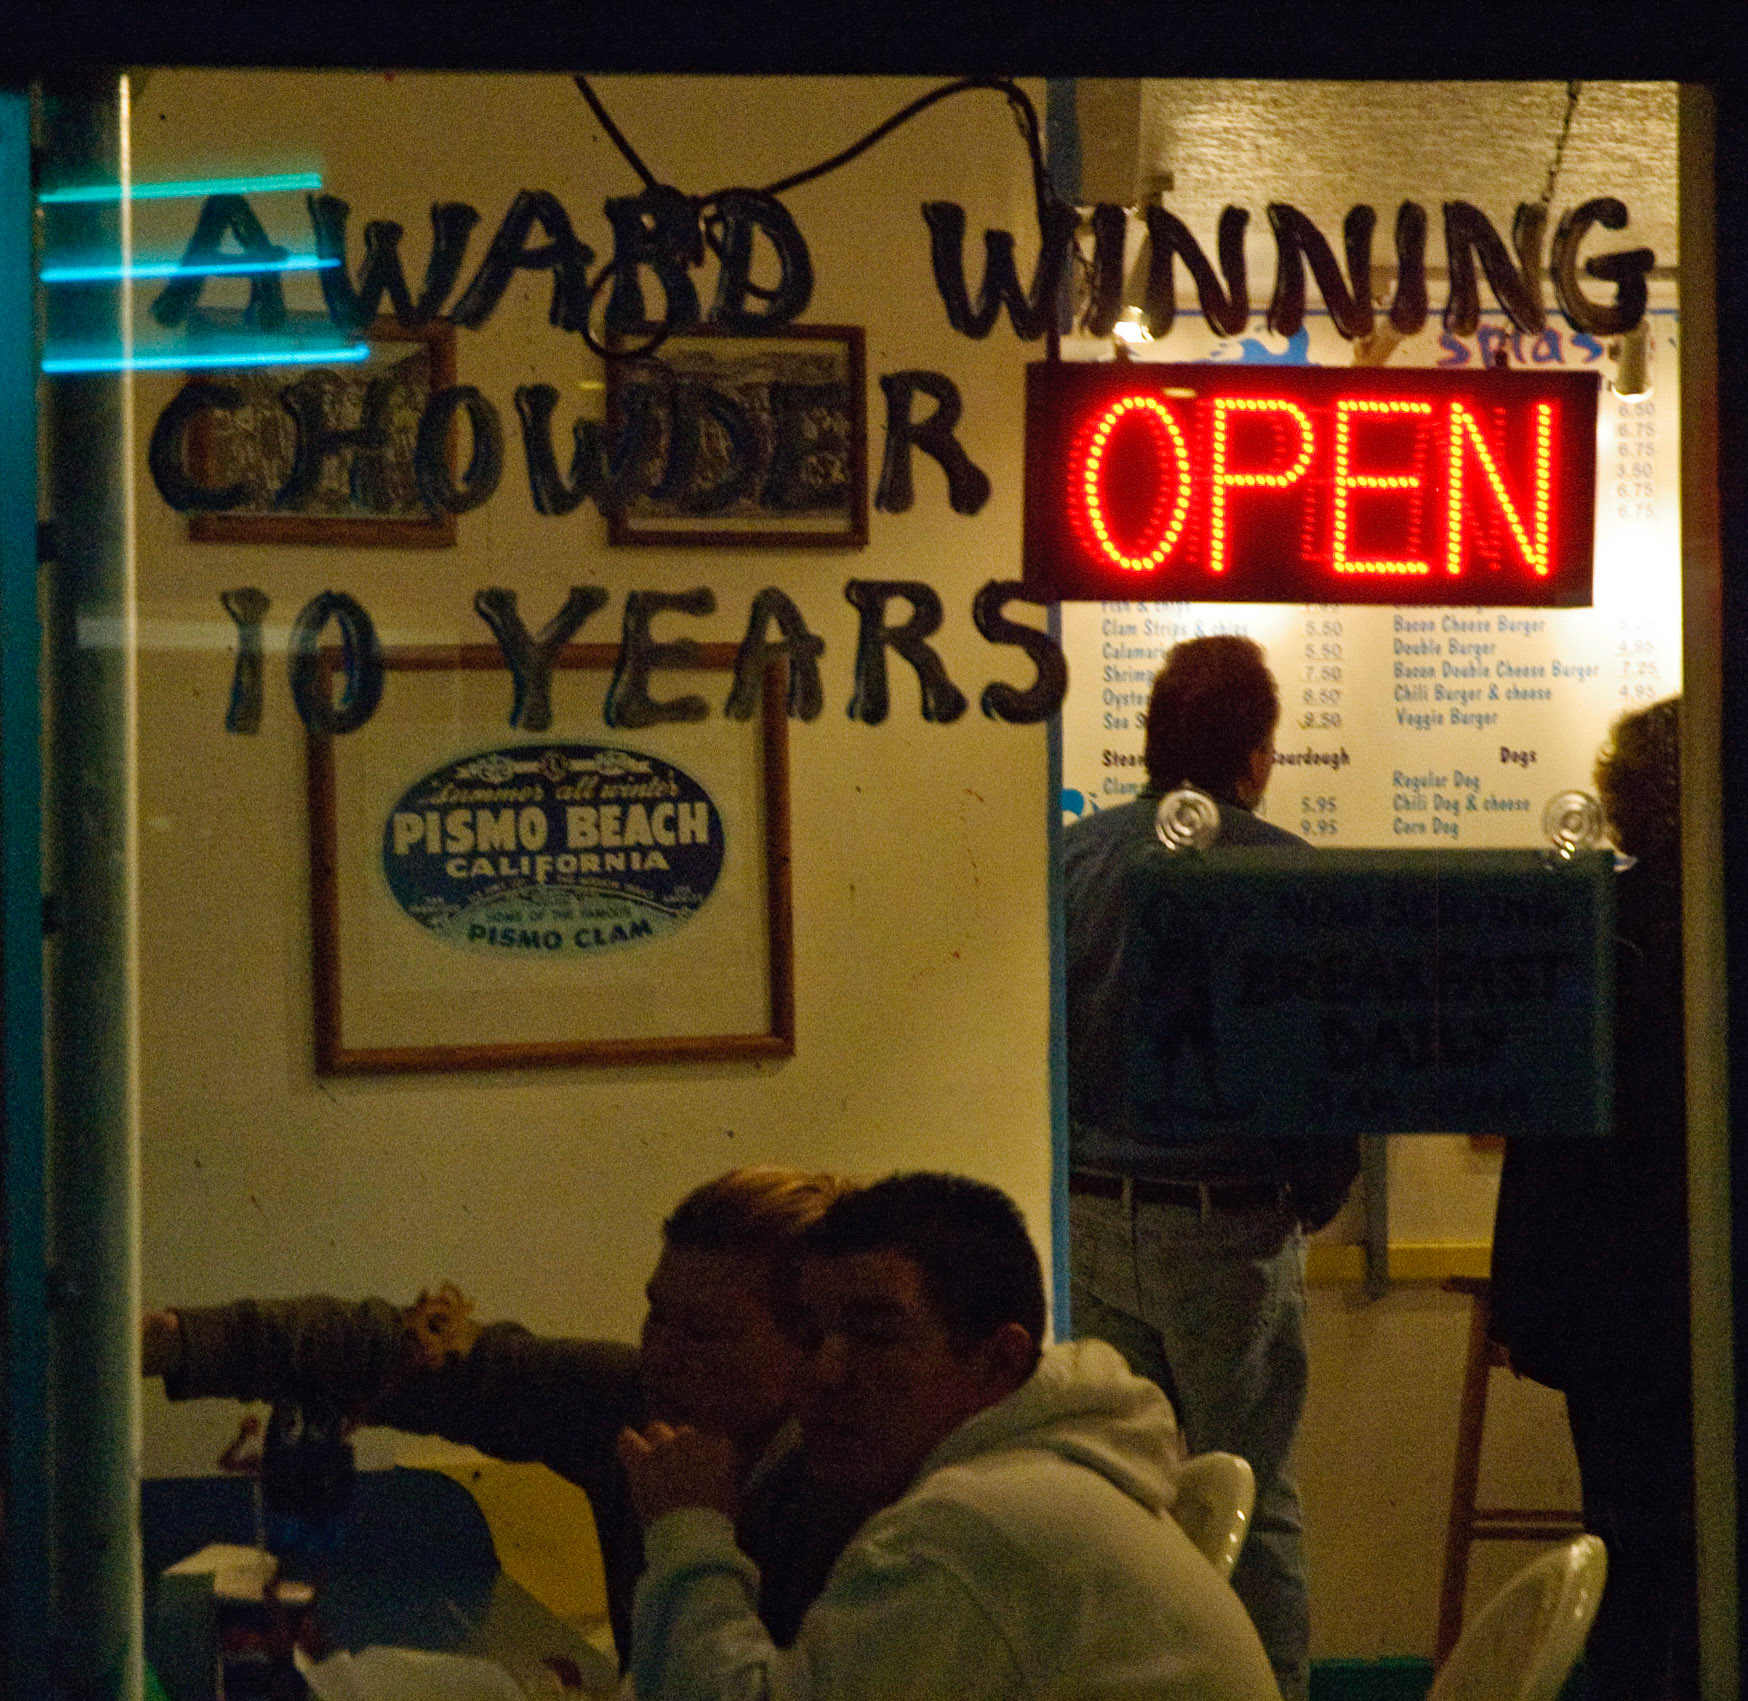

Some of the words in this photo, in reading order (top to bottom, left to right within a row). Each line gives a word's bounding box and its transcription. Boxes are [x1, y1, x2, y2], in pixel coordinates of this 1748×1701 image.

[152, 187, 813, 332] AWARD
[923, 198, 1654, 340] WINNING
[151, 368, 990, 516] CHOWDER
[1083, 396, 1549, 576] OPEN
[1102, 618, 1137, 636] Clam
[1144, 618, 1187, 639] Strips
[1394, 615, 1436, 633] Bacon
[1442, 615, 1491, 633] Cheese
[1498, 615, 1545, 637] Burger
[220, 586, 385, 734] 10
[475, 580, 1068, 732] YEARS
[1394, 638, 1443, 657] Double
[1448, 638, 1496, 660] Burger
[1394, 662, 1436, 680] Bacon
[1442, 661, 1490, 679] Double
[1496, 661, 1546, 679] Cheese
[1552, 661, 1600, 683] Burger
[1394, 683, 1428, 702] Chili
[1434, 683, 1482, 705] Burger
[1488, 683, 1499, 701] &
[1505, 684, 1553, 702] cheese
[1103, 711, 1129, 729] Sea
[1396, 708, 1444, 731] Veggie
[1450, 708, 1498, 731] Burger
[1272, 745, 1351, 770] ourdough
[1499, 745, 1538, 768] Dogs
[1393, 770, 1448, 790] Regular
[1453, 770, 1480, 791] Dog
[1393, 793, 1427, 812] Chili
[1433, 793, 1460, 815] Dog
[1465, 793, 1477, 812] &
[1483, 794, 1531, 812] cheese
[392, 806, 548, 857] PISMO
[565, 801, 709, 849] BEACH
[1393, 817, 1427, 835] Corn
[1433, 817, 1460, 839] Dog
[445, 850, 670, 884] CALIFORNIA
[467, 923, 562, 951] PISMO
[574, 919, 653, 948] CLAM
